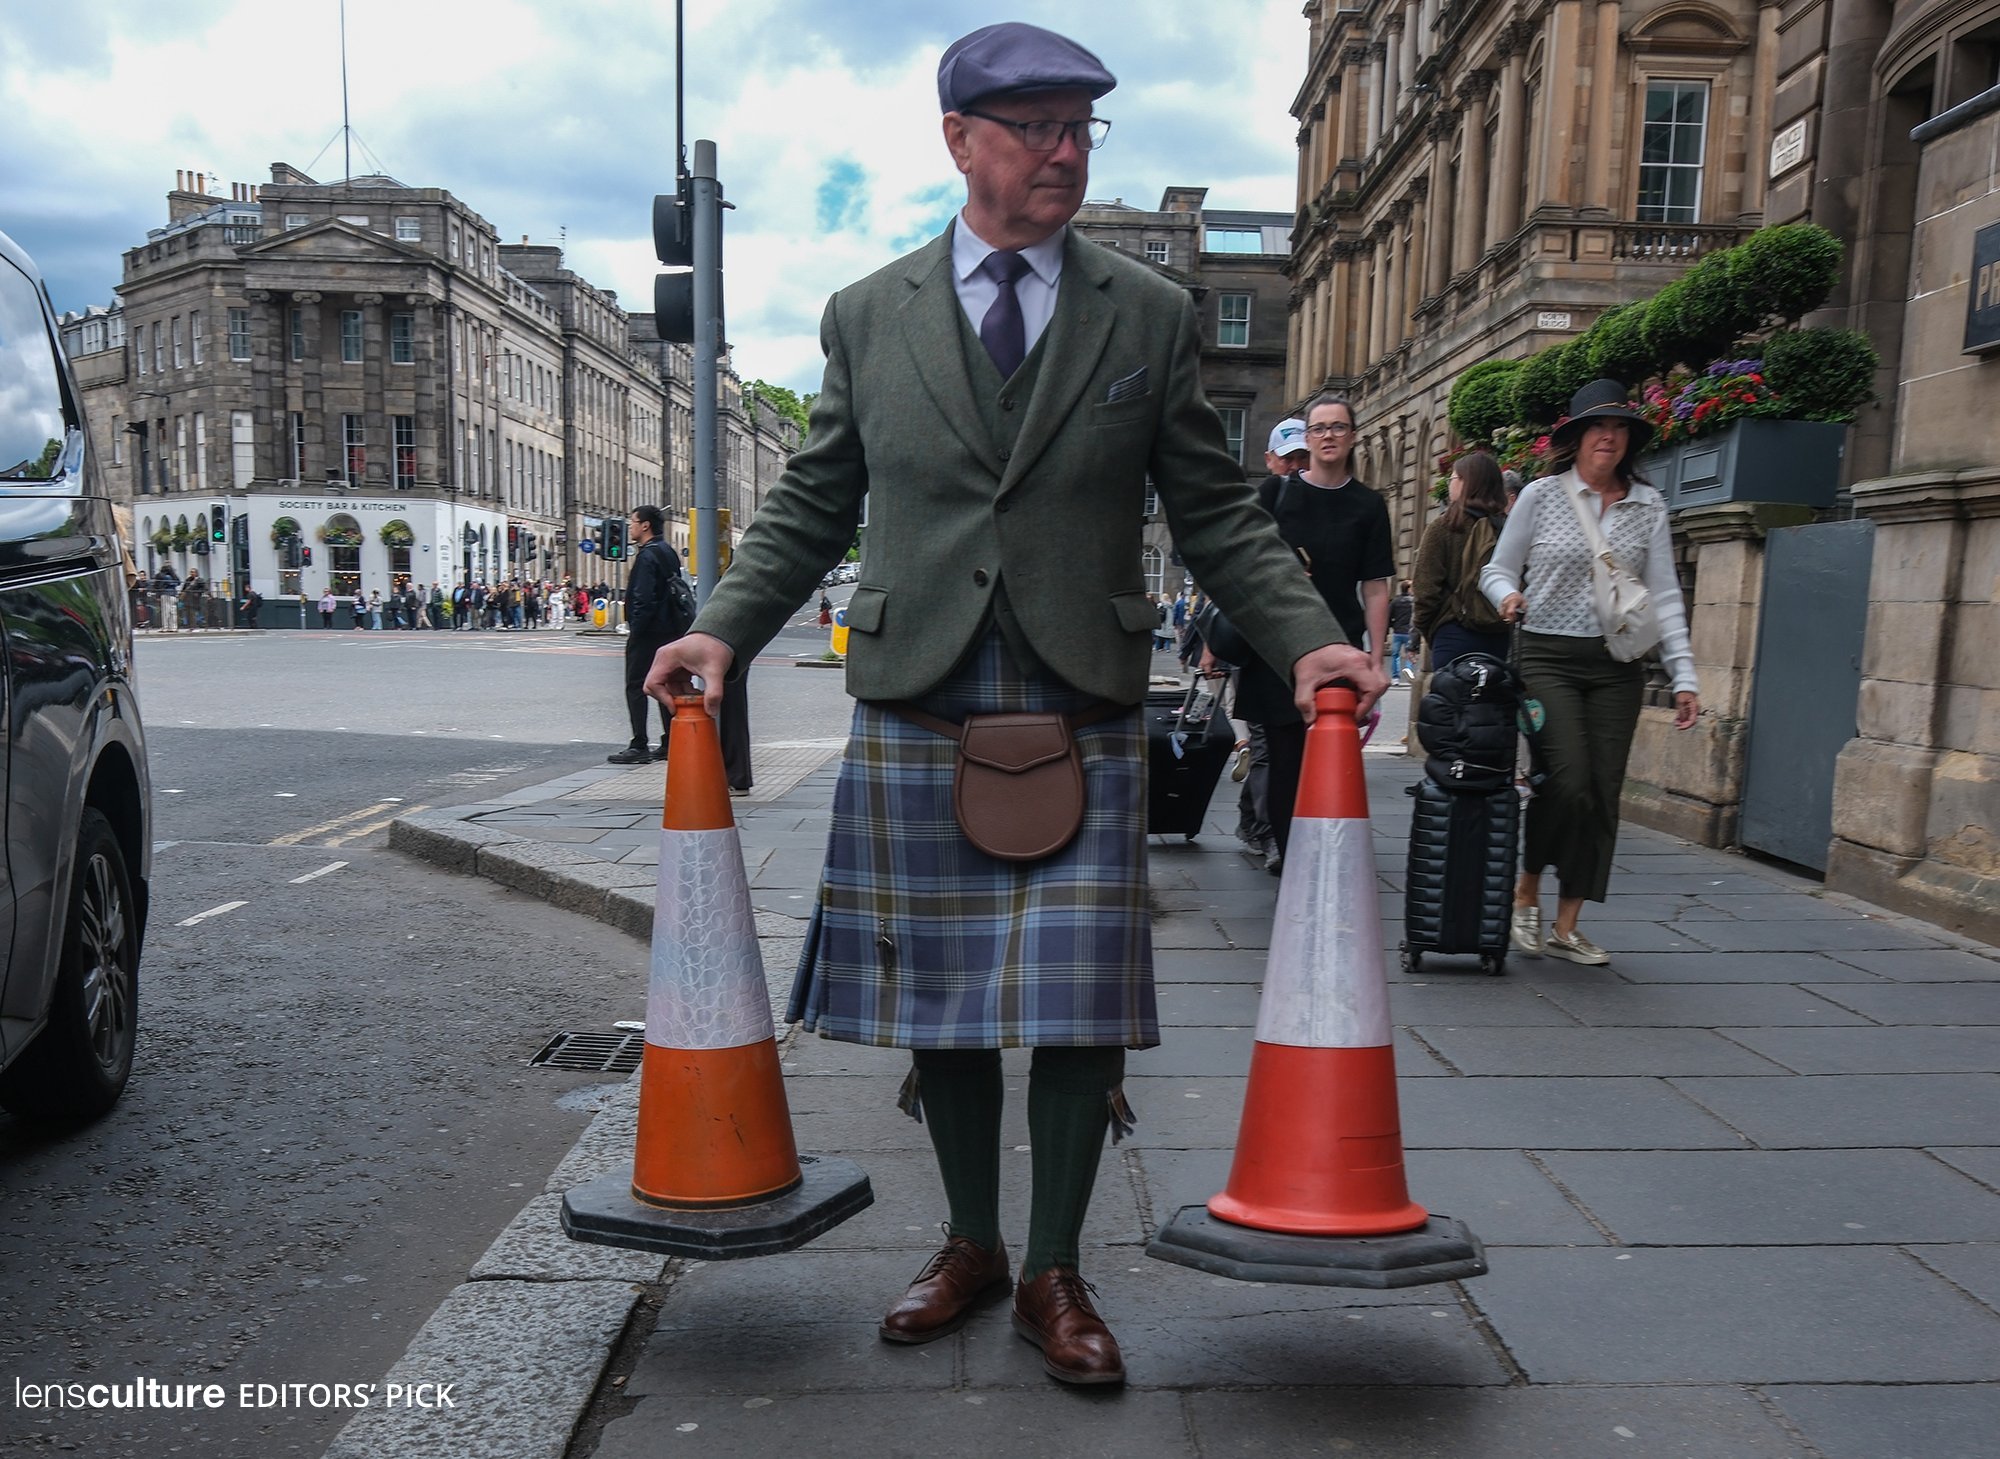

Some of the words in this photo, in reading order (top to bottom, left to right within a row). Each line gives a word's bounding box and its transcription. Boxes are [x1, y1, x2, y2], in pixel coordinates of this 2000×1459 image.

[279, 501, 323, 509] SOCIETY
[326, 502, 348, 510] BAR
[351, 502, 358, 510] &
[361, 503, 407, 512] KITCHEN
